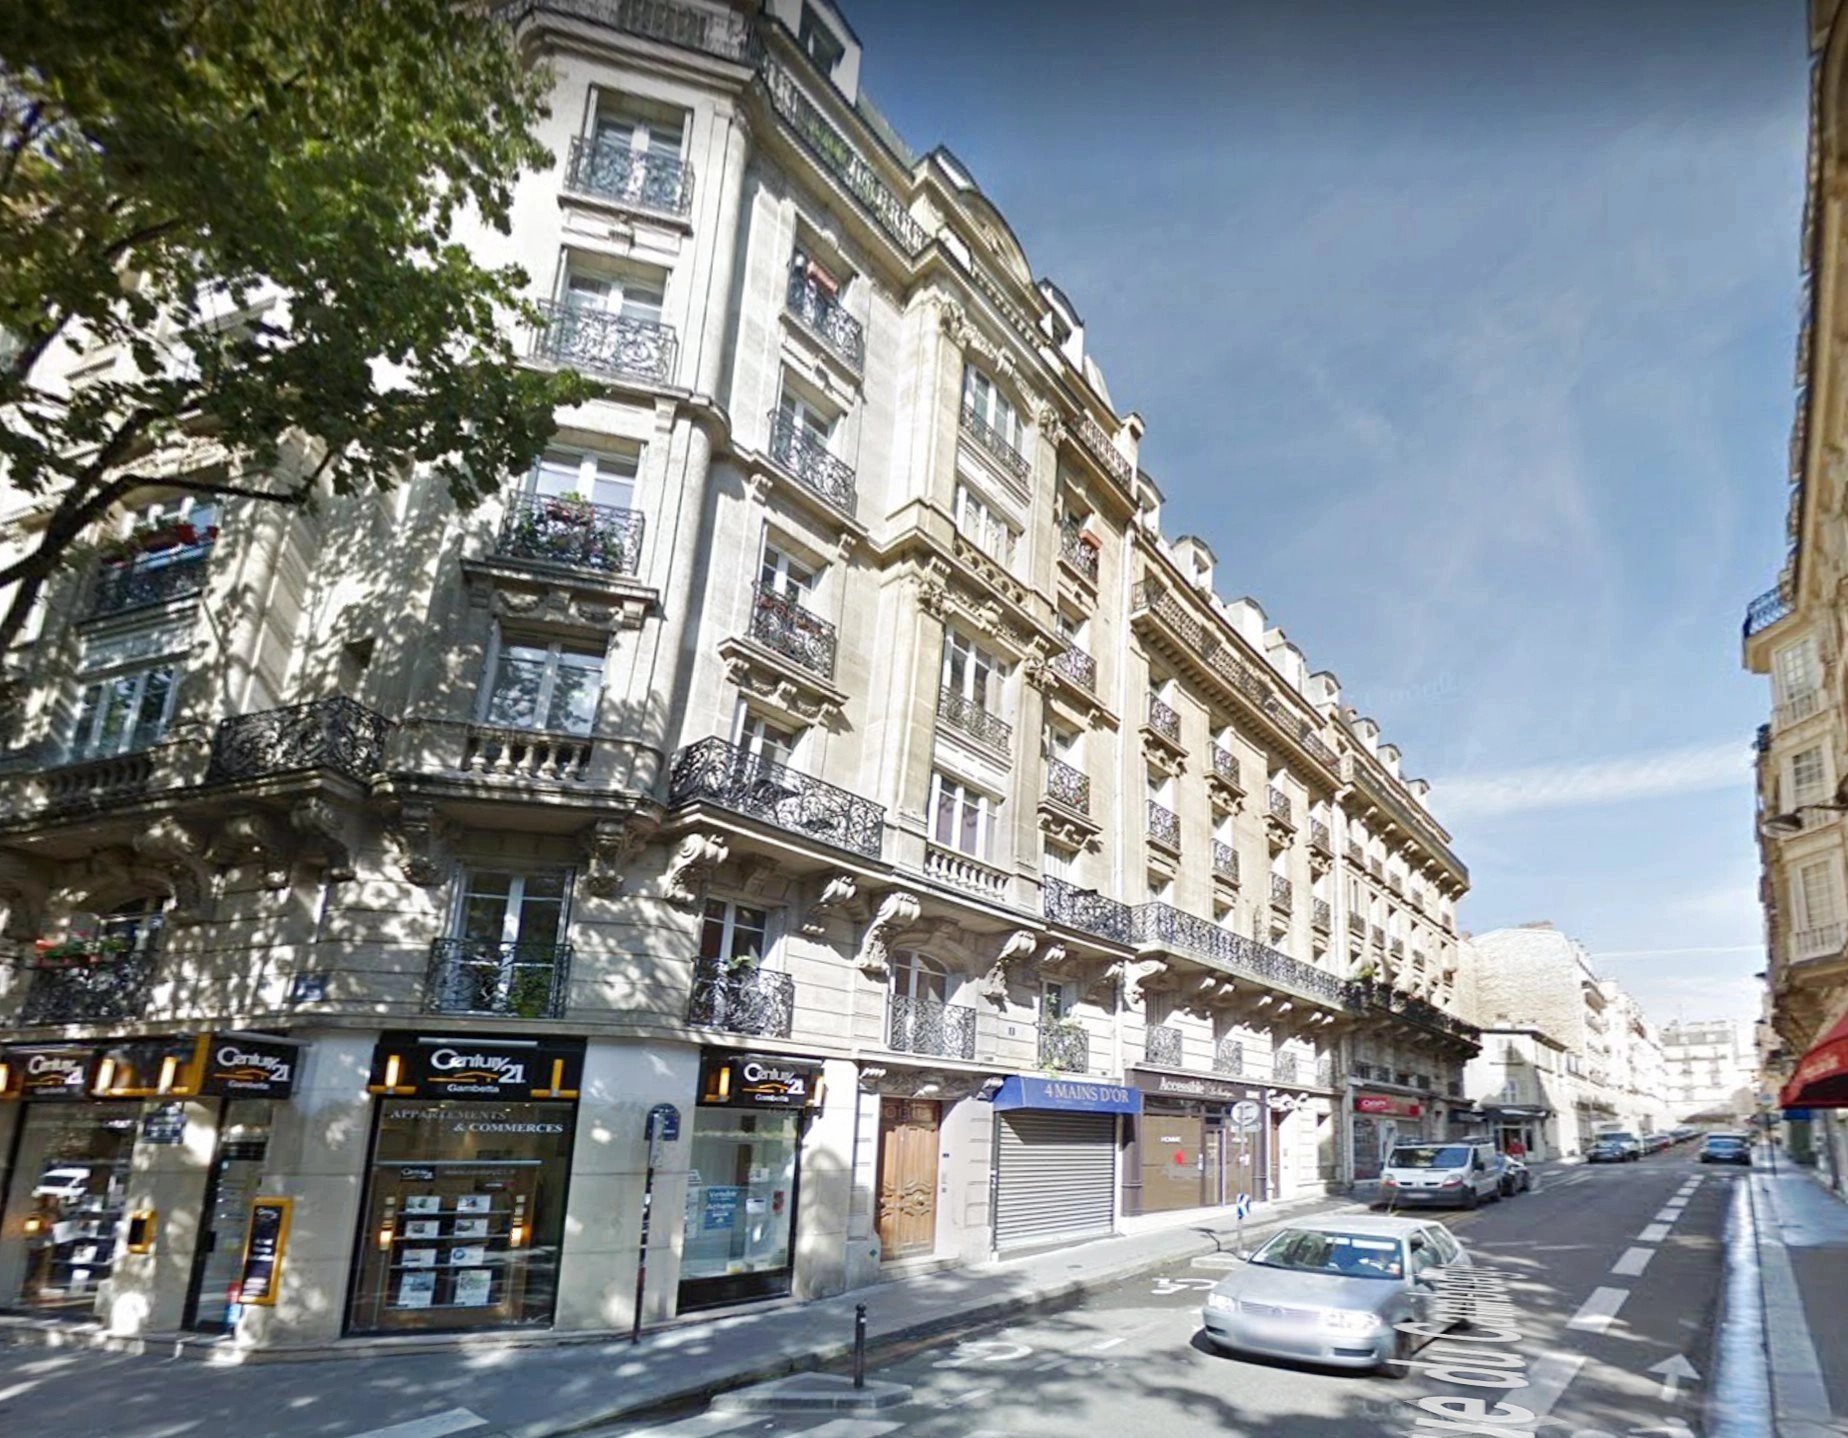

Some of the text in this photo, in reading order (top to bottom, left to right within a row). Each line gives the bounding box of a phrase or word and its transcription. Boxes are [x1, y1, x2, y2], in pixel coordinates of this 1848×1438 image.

[28, 1055, 77, 1075] Century
[217, 1046, 290, 1081] Century 21
[430, 1049, 526, 1083] Century 21
[447, 1083, 500, 1093] Gambetta
[743, 1062, 805, 1095] Century 21
[1044, 1083, 1130, 1103] 4 MAINS D'OR
[390, 1109, 508, 1121] APPARTEMENTS
[453, 1122, 564, 1134] & COMMERCES
